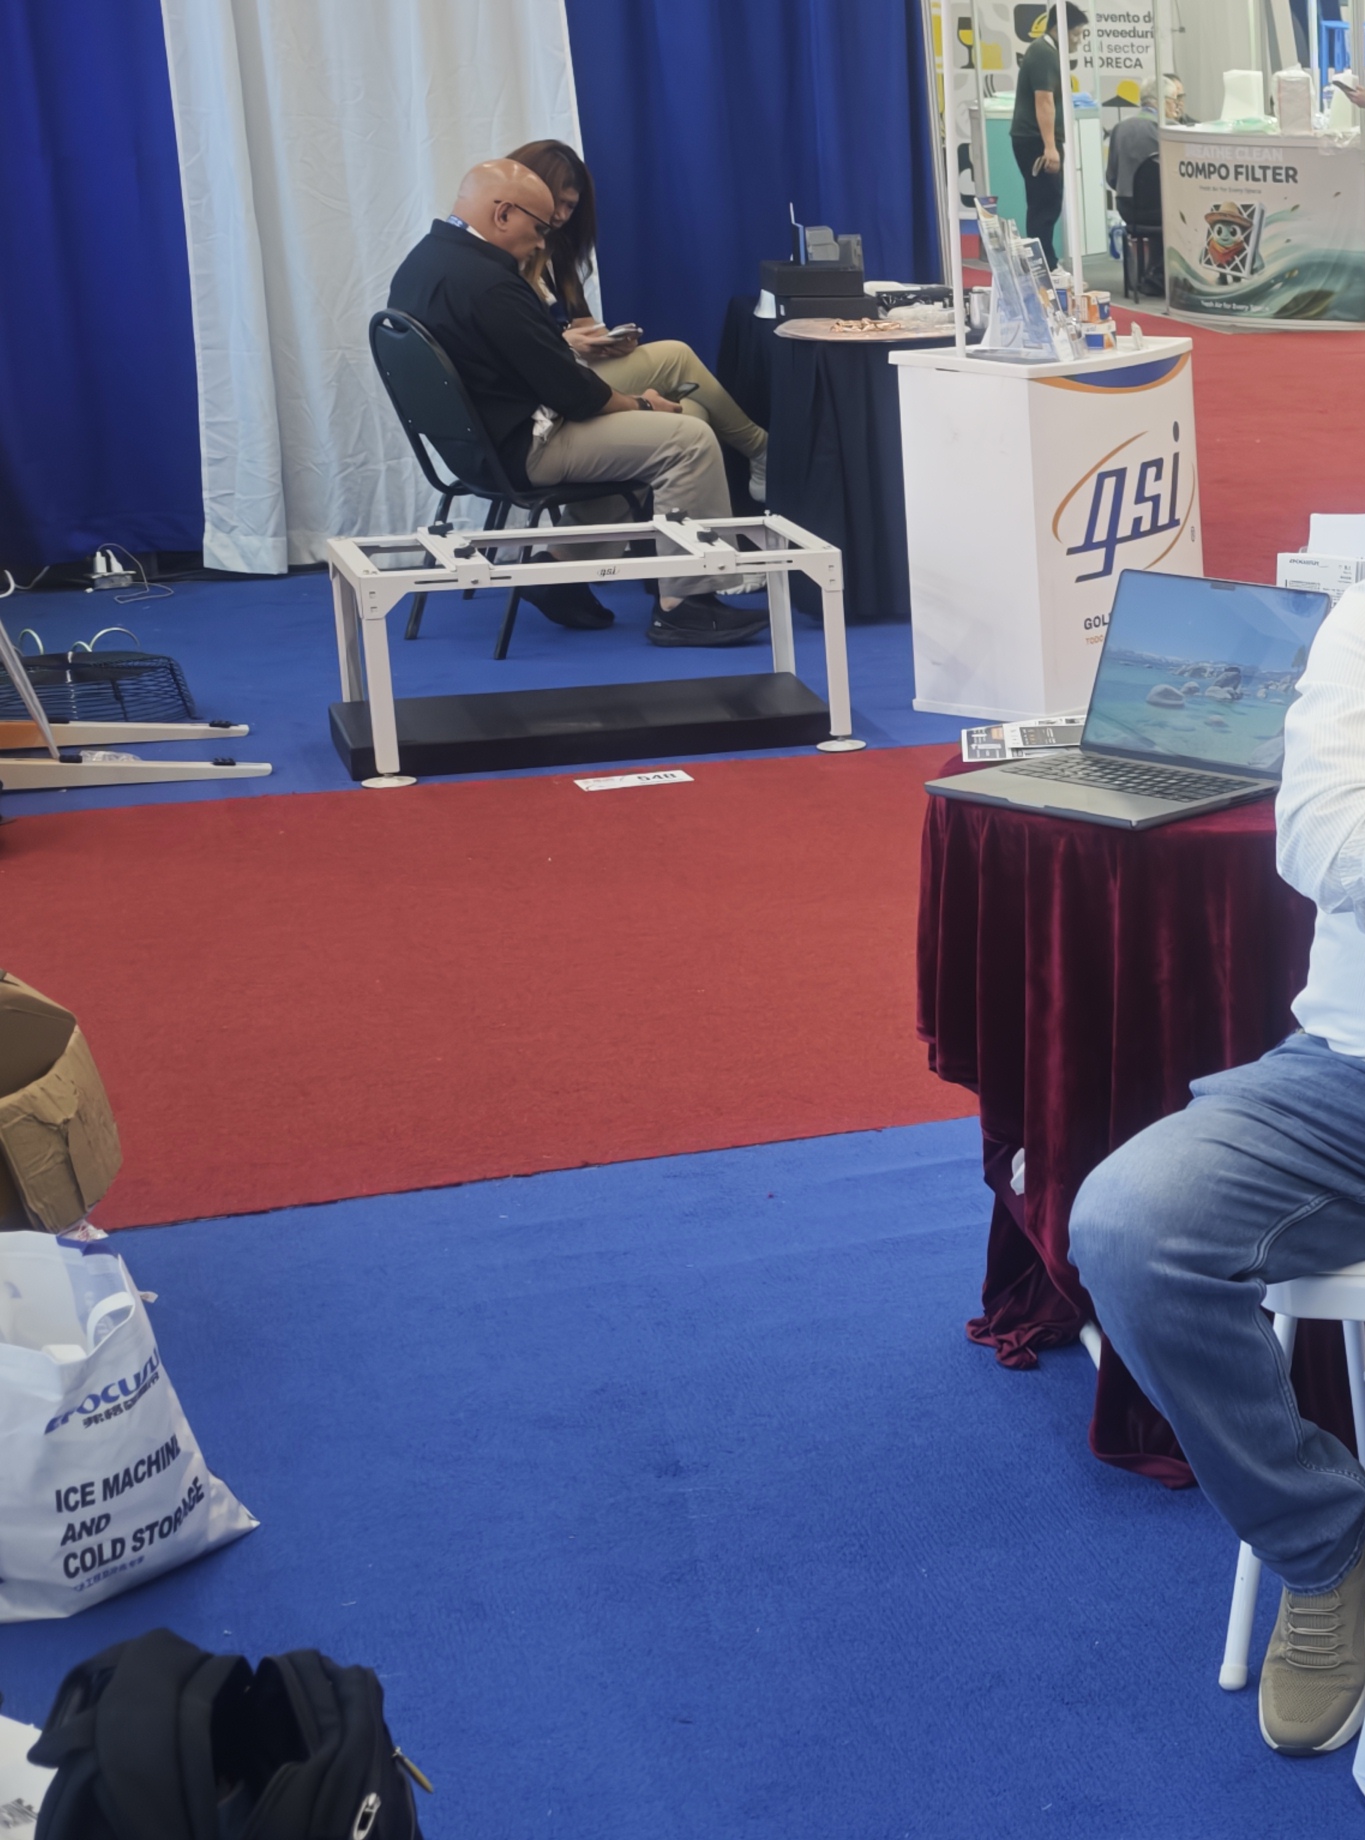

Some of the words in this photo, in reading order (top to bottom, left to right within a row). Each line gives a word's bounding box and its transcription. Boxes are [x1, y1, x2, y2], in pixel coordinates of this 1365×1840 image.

[1096, 11, 1140, 23] evento
[1143, 10, 1153, 23] d
[1083, 40, 1103, 53] dl
[1107, 42, 1150, 54] sector
[1084, 56, 1143, 69] HORECA
[1240, 146, 1284, 162] CLEAN
[1179, 161, 1230, 181] COMPO
[1234, 164, 1299, 184] FILTER
[1083, 612, 1112, 631] GOL
[55, 1481, 95, 1514] ICE
[60, 1512, 111, 1547] AND
[63, 1537, 126, 1580] COLD
[131, 1476, 205, 1552] STORAGE
